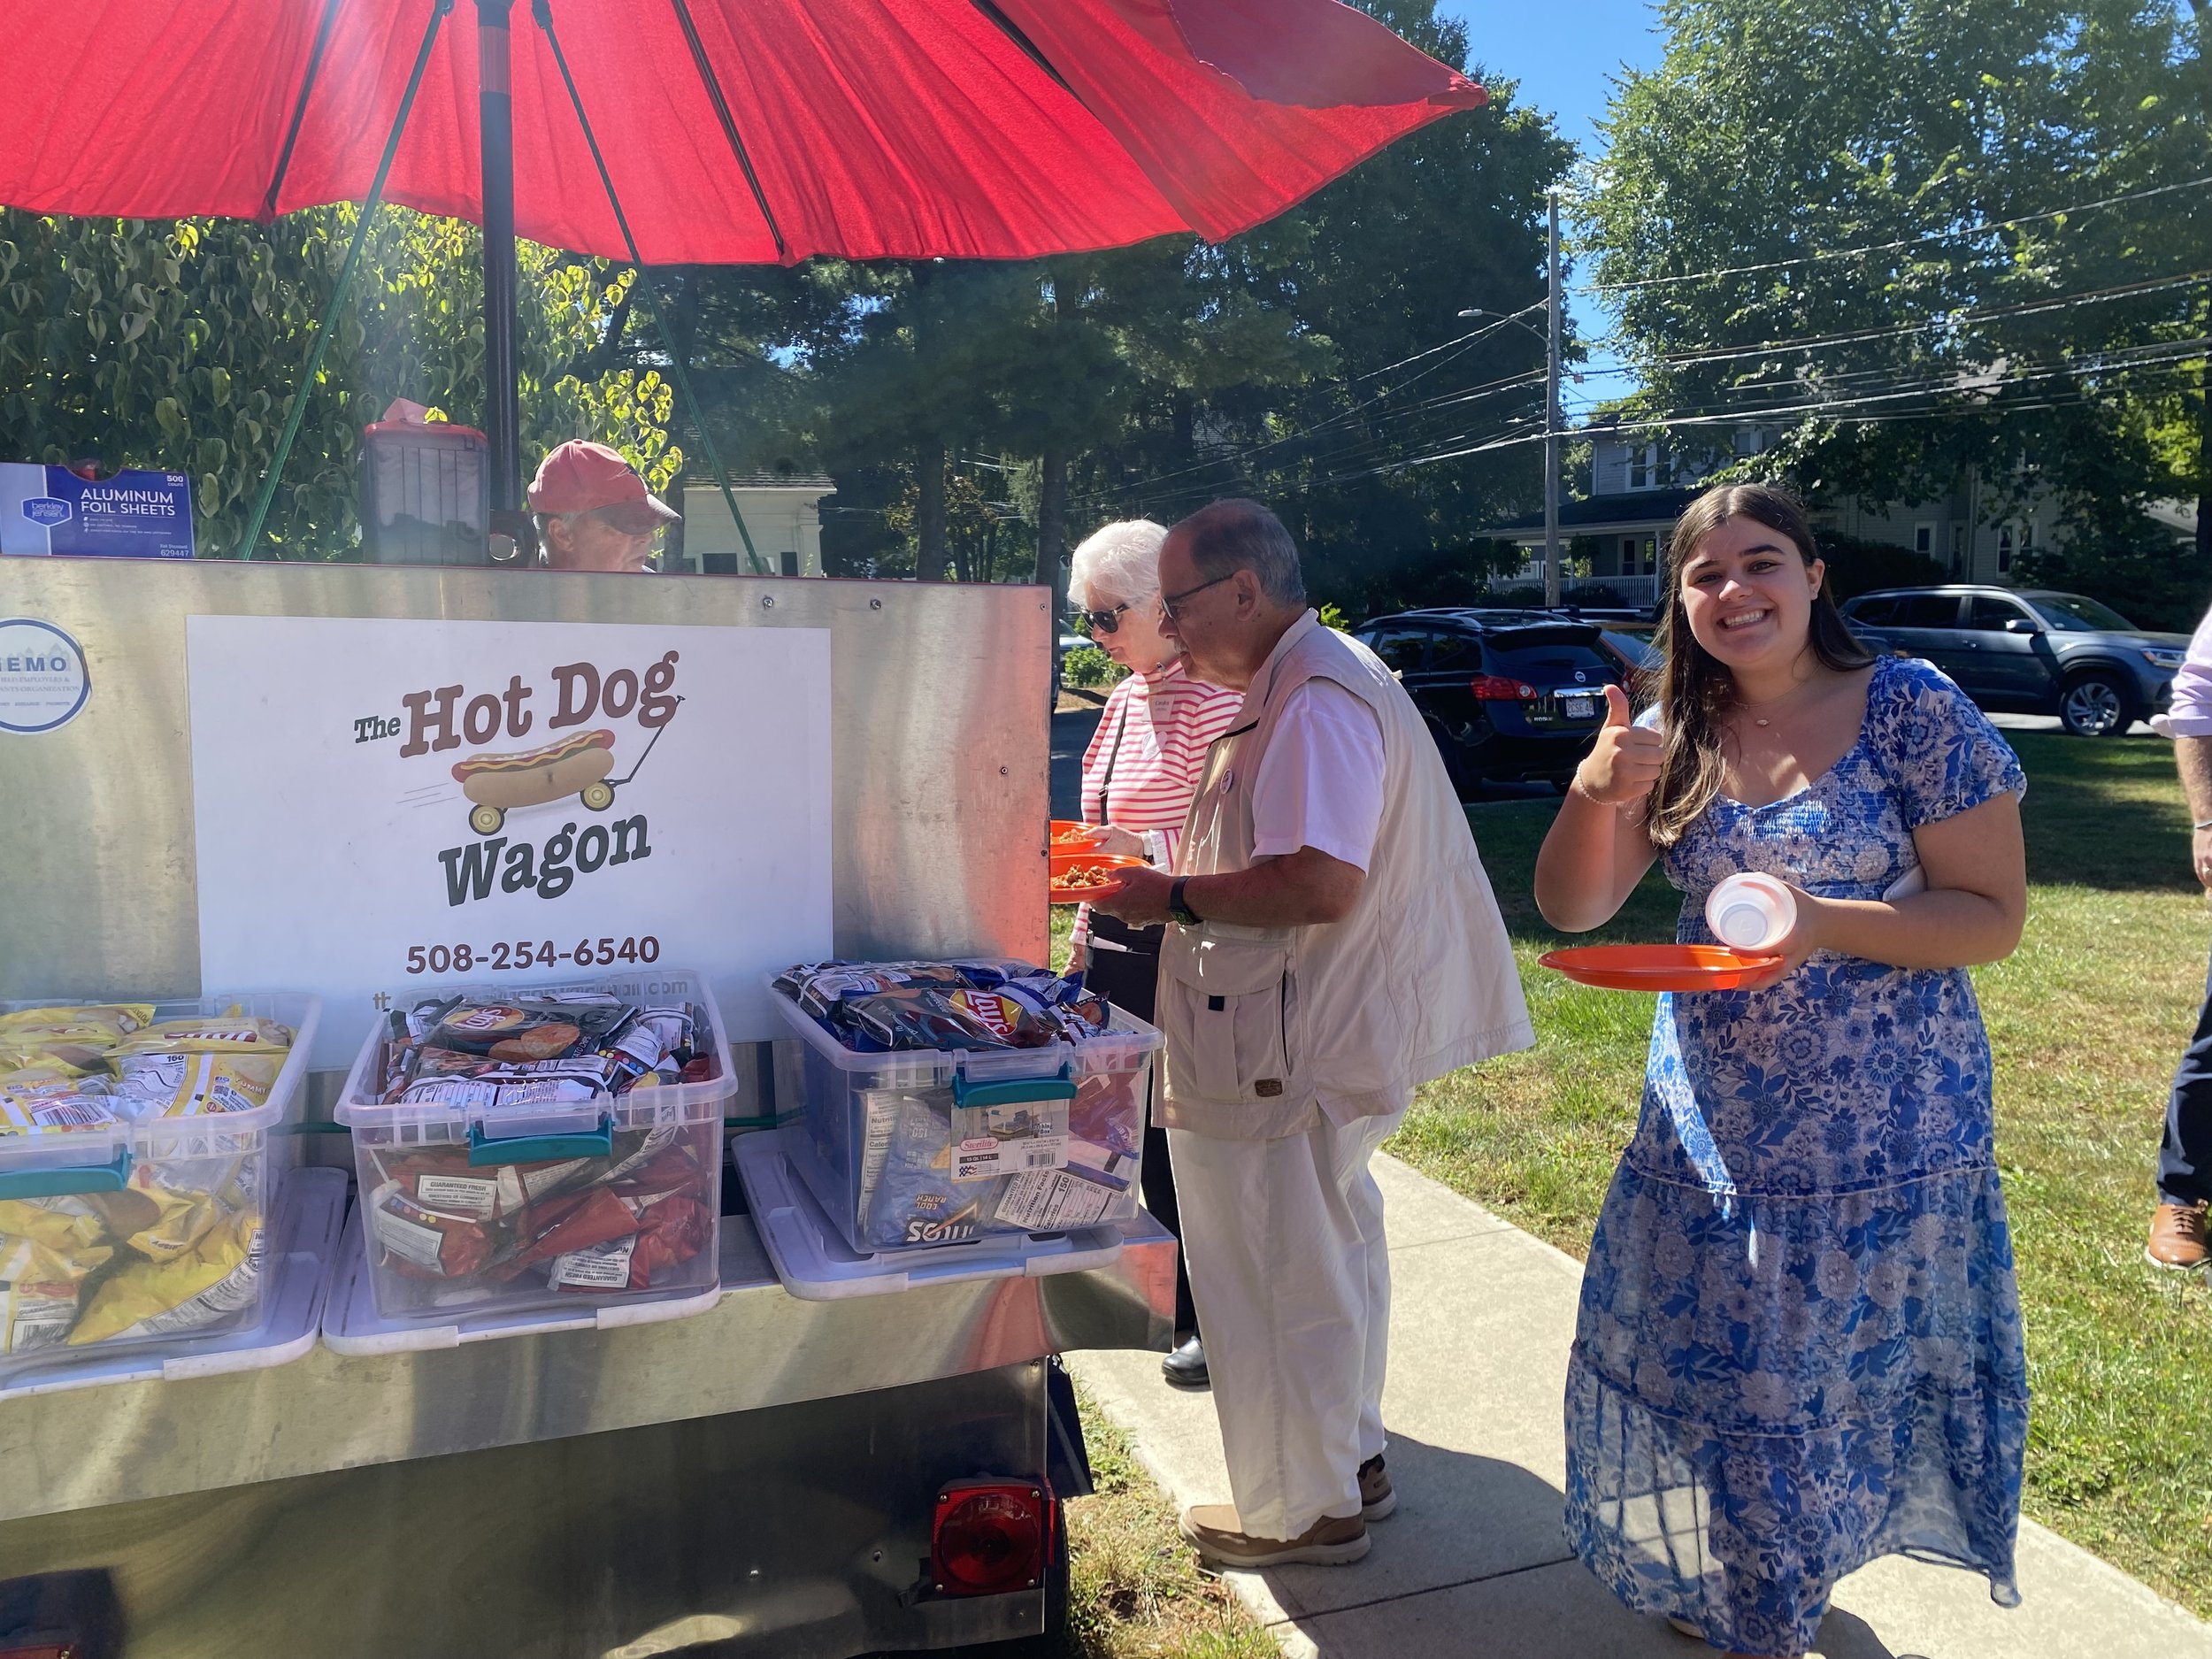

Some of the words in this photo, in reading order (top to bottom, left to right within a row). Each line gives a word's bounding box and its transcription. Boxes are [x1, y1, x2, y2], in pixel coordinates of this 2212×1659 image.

[81, 488, 173, 503] ALUMINUM
[31, 501, 65, 512] berkley
[81, 502, 116, 513] FOIL
[120, 503, 176, 516] SHEETS
[0, 657, 67, 672] EMO
[354, 715, 401, 743] The
[400, 675, 533, 757] Hot
[549, 650, 680, 728] Dog
[438, 815, 651, 907] Wagon
[405, 935, 660, 974] 508-254-6540
[1079, 996, 1106, 1006] MOKY
[132, 1007, 149, 1024] POTAT
[456, 1007, 507, 1030] Lay's
[964, 990, 1011, 1035] Lay's
[964, 1139, 993, 1149] Sterilite
[430, 1181, 467, 1190] GUARANTEED
[916, 1194, 947, 1203] RANCH
[917, 1202, 938, 1210] COOL
[1043, 1203, 1059, 1230] Calories
[1058, 1177, 1070, 1193] 150
[1022, 1191, 1041, 1223] Nutrition
